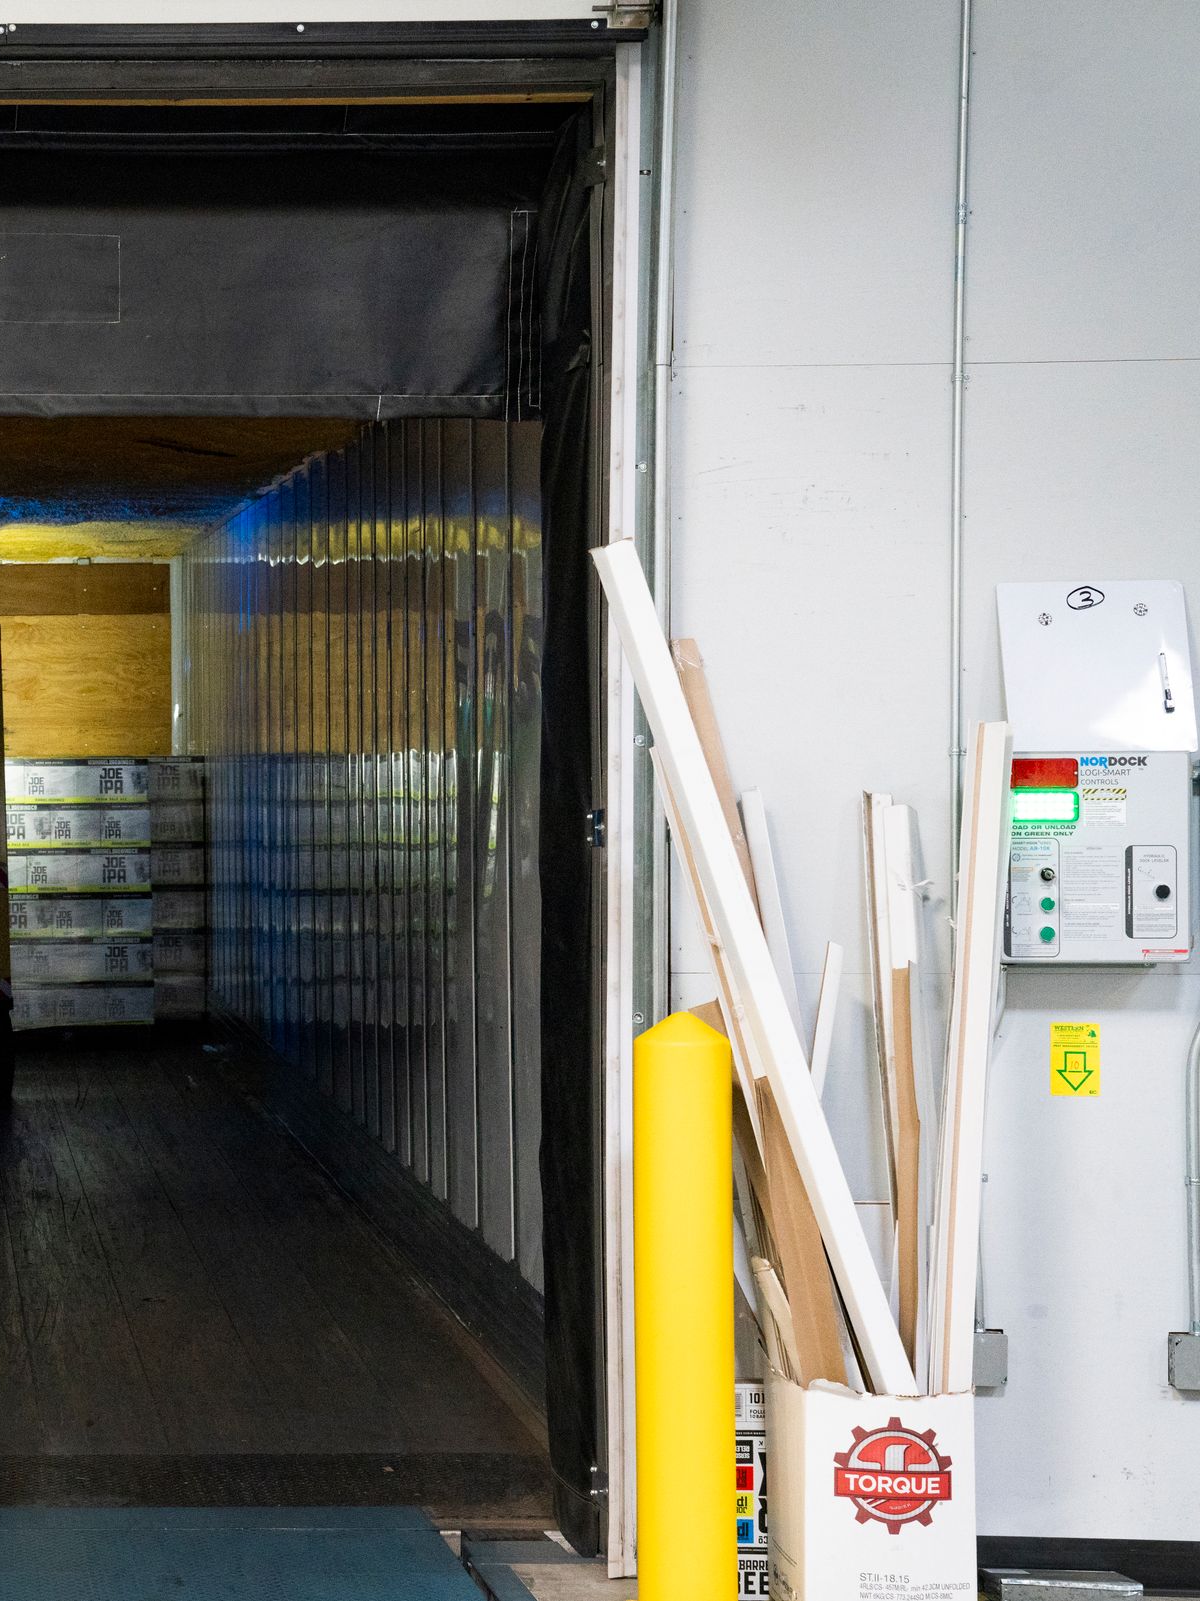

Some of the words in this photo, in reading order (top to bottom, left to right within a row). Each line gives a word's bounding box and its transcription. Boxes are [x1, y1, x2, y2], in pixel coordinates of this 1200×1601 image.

[1078, 590, 1094, 608] 3
[1080, 756, 1148, 768] NORDOCK
[100, 768, 123, 779] JOE
[1080, 768, 1131, 776] LOGI-SMART
[28, 777, 44, 785] JOE
[28, 785, 45, 795] IPA
[100, 780, 124, 794] IPA
[55, 821, 71, 829] JOE
[105, 821, 121, 829] JOE
[55, 830, 71, 839] IPA
[105, 830, 121, 839] IPA
[103, 857, 126, 868] JOE
[31, 866, 47, 874] JOE
[31, 875, 47, 884] IPA
[102, 869, 126, 883] IPA
[56, 911, 72, 919] JOE
[107, 910, 123, 918] JOE
[56, 919, 73, 928] IPA
[106, 918, 123, 928] IPA
[105, 946, 128, 957] JOE
[105, 958, 128, 972] IPA
[844, 1473, 941, 1494] TORQUE
